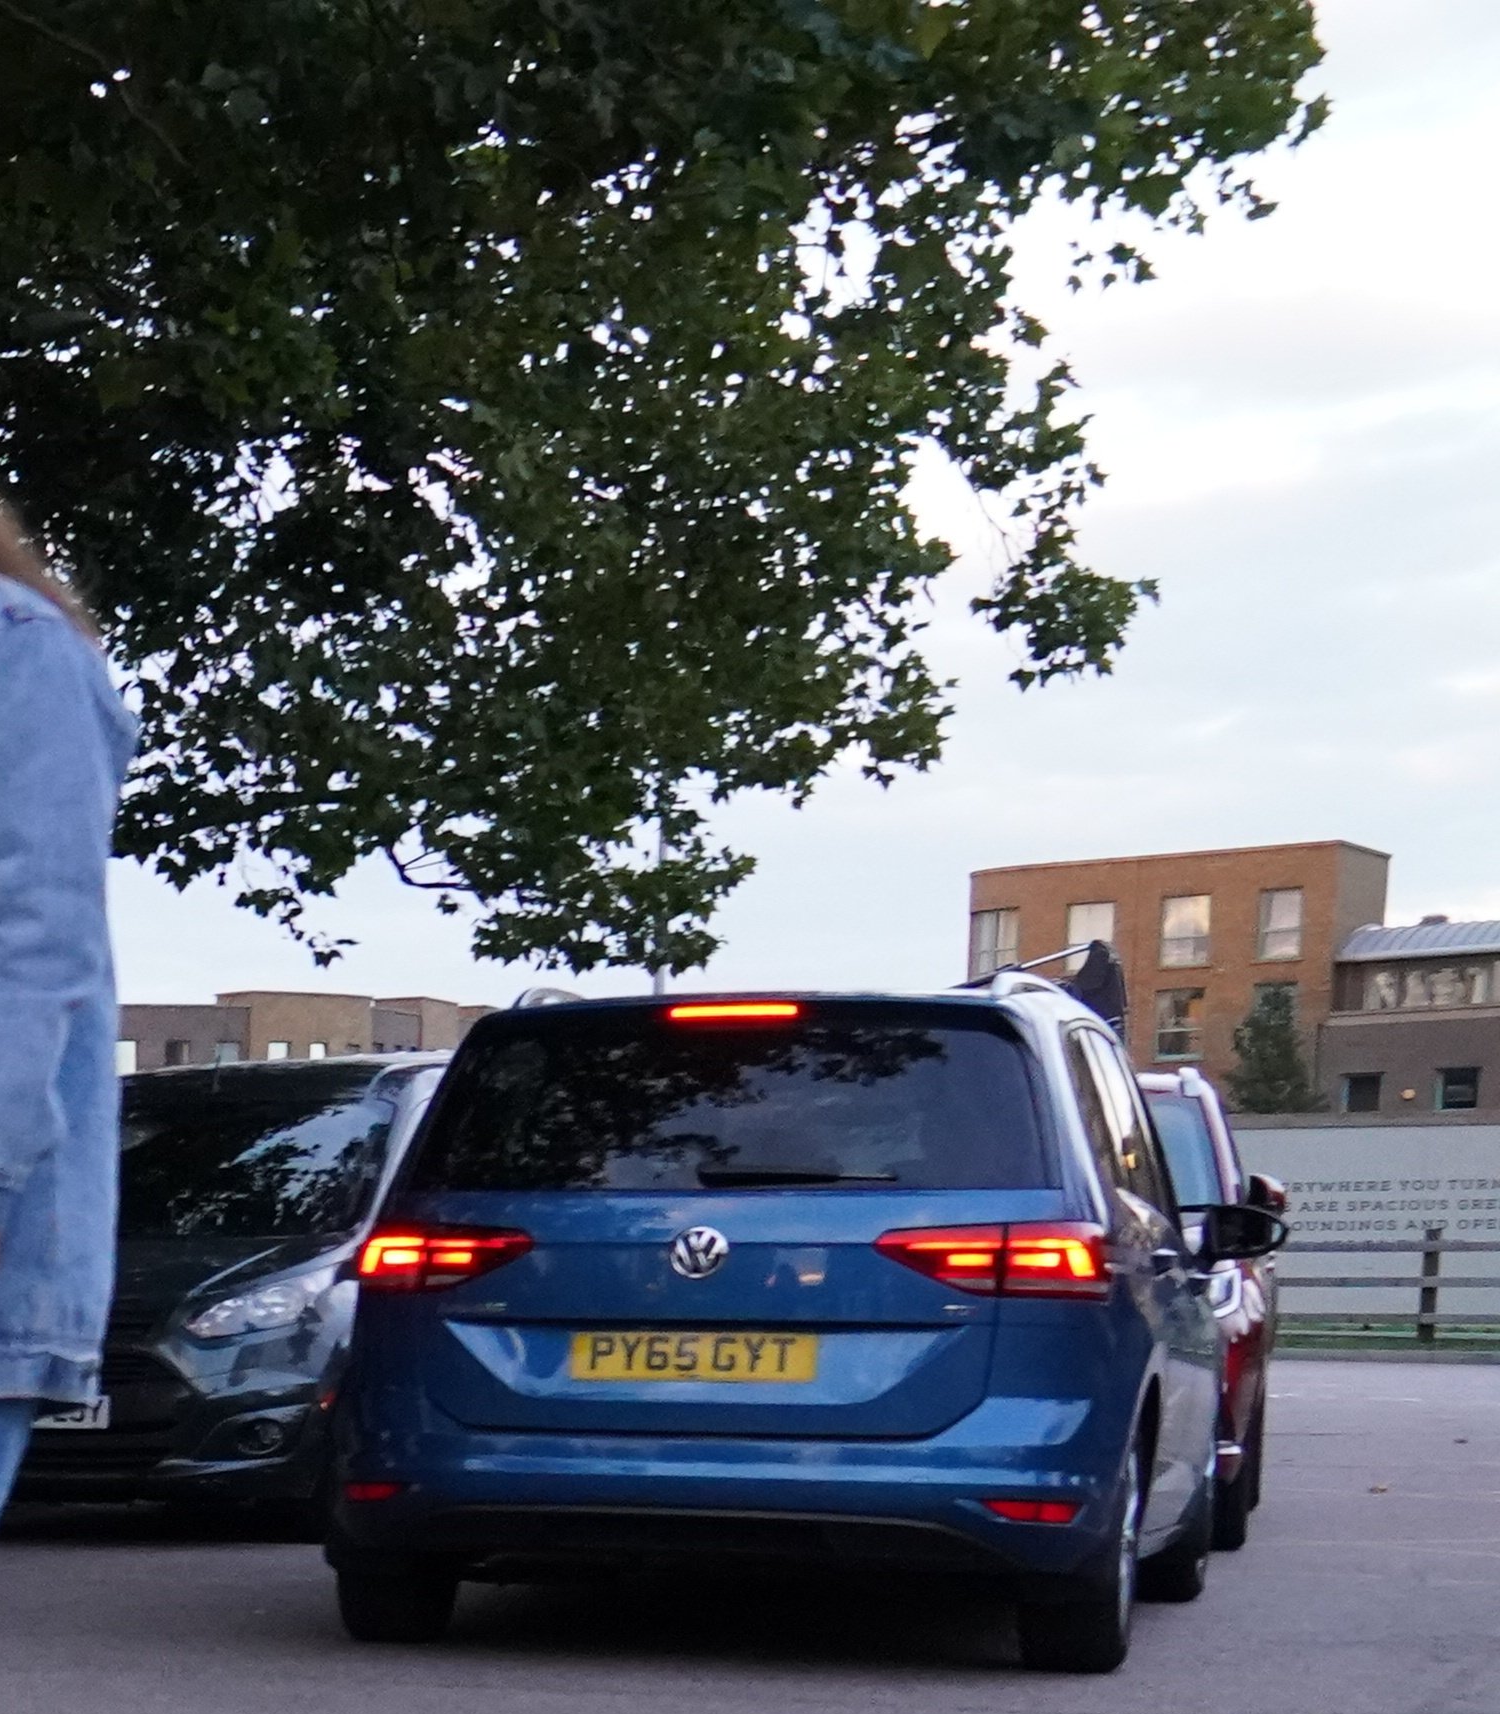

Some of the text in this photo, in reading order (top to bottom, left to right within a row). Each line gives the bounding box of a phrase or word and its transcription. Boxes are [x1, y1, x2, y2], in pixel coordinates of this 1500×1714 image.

[1399, 1179, 1441, 1191] YOU
[1299, 1200, 1340, 1212] ARE
[1347, 1199, 1450, 1212] SPACIOUS
[1457, 1198, 1500, 1211] GRE
[1291, 1218, 1500, 1232] OUNDINGS AND OPE
[590, 1335, 797, 1372] PY65 GYT
